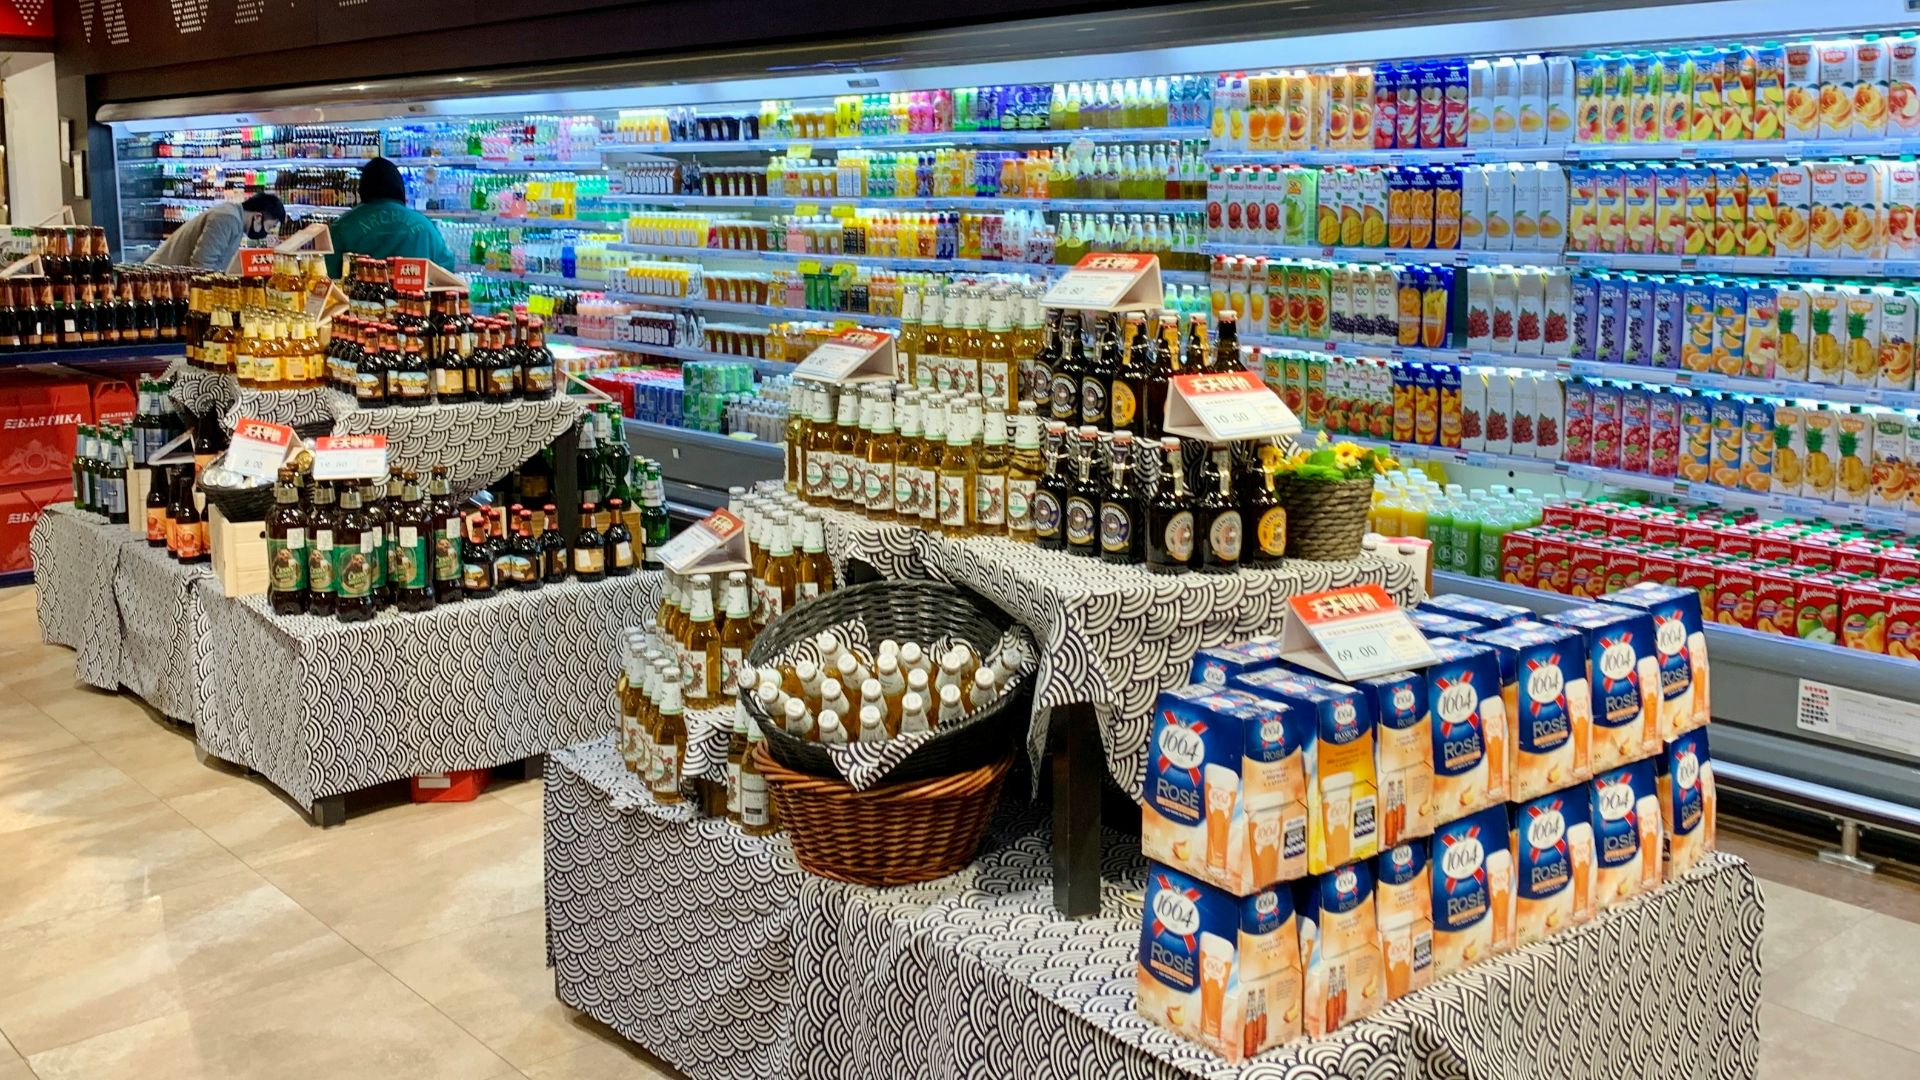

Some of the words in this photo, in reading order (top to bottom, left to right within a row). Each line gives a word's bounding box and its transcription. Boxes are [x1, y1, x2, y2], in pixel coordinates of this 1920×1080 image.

[1190, 375, 1254, 393] 天天平价
[1213, 411, 1250, 425] 10.50
[1307, 591, 1381, 620] 天天平价
[1337, 645, 1378, 662] 69.00
[1604, 649, 1632, 671] 1664
[1531, 673, 1560, 697] 1664
[1661, 662, 1689, 686] ROSÉ
[1442, 688, 1474, 715] 1664
[1604, 689, 1639, 713] ROSÉ
[1532, 713, 1568, 739] ROSÉ
[1161, 729, 1201, 762] 1664
[1443, 732, 1481, 760] ROSÉ
[1156, 777, 1201, 810] ROSÉ
[1531, 820, 1561, 843] 1664
[1447, 844, 1479, 871] 1664
[1531, 858, 1568, 884] ROSÉ
[1155, 894, 1195, 929] 1664
[1446, 886, 1487, 916] ROSÉ
[1150, 942, 1195, 978] ROSÉ
